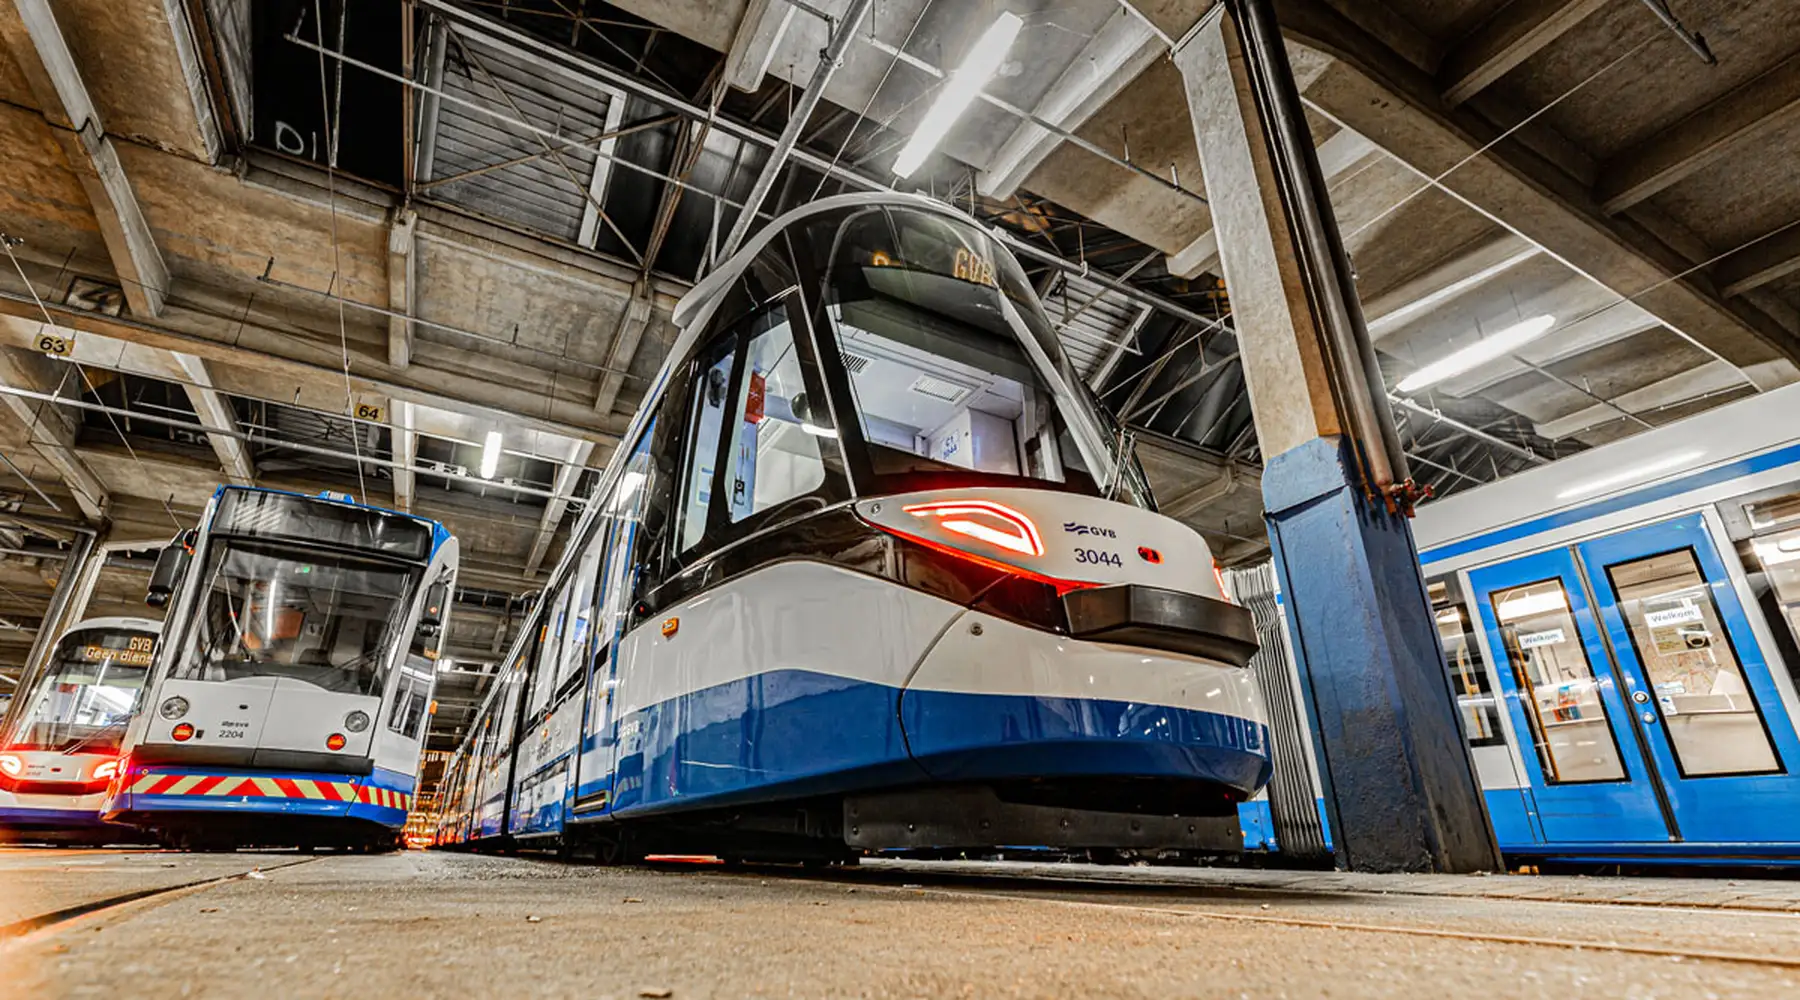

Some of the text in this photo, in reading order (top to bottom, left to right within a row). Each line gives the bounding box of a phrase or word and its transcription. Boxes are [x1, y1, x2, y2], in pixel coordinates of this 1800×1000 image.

[954, 247, 994, 286] GVB
[40, 336, 66, 353] 63
[359, 405, 379, 420] 64
[1089, 526, 1117, 539] GVB
[1073, 547, 1123, 568] 3044
[1651, 609, 1696, 623] Welkom
[129, 636, 153, 653] GVB
[1523, 632, 1560, 645] Welkom
[87, 646, 154, 665] Geen diens
[218, 729, 244, 739] 2204
